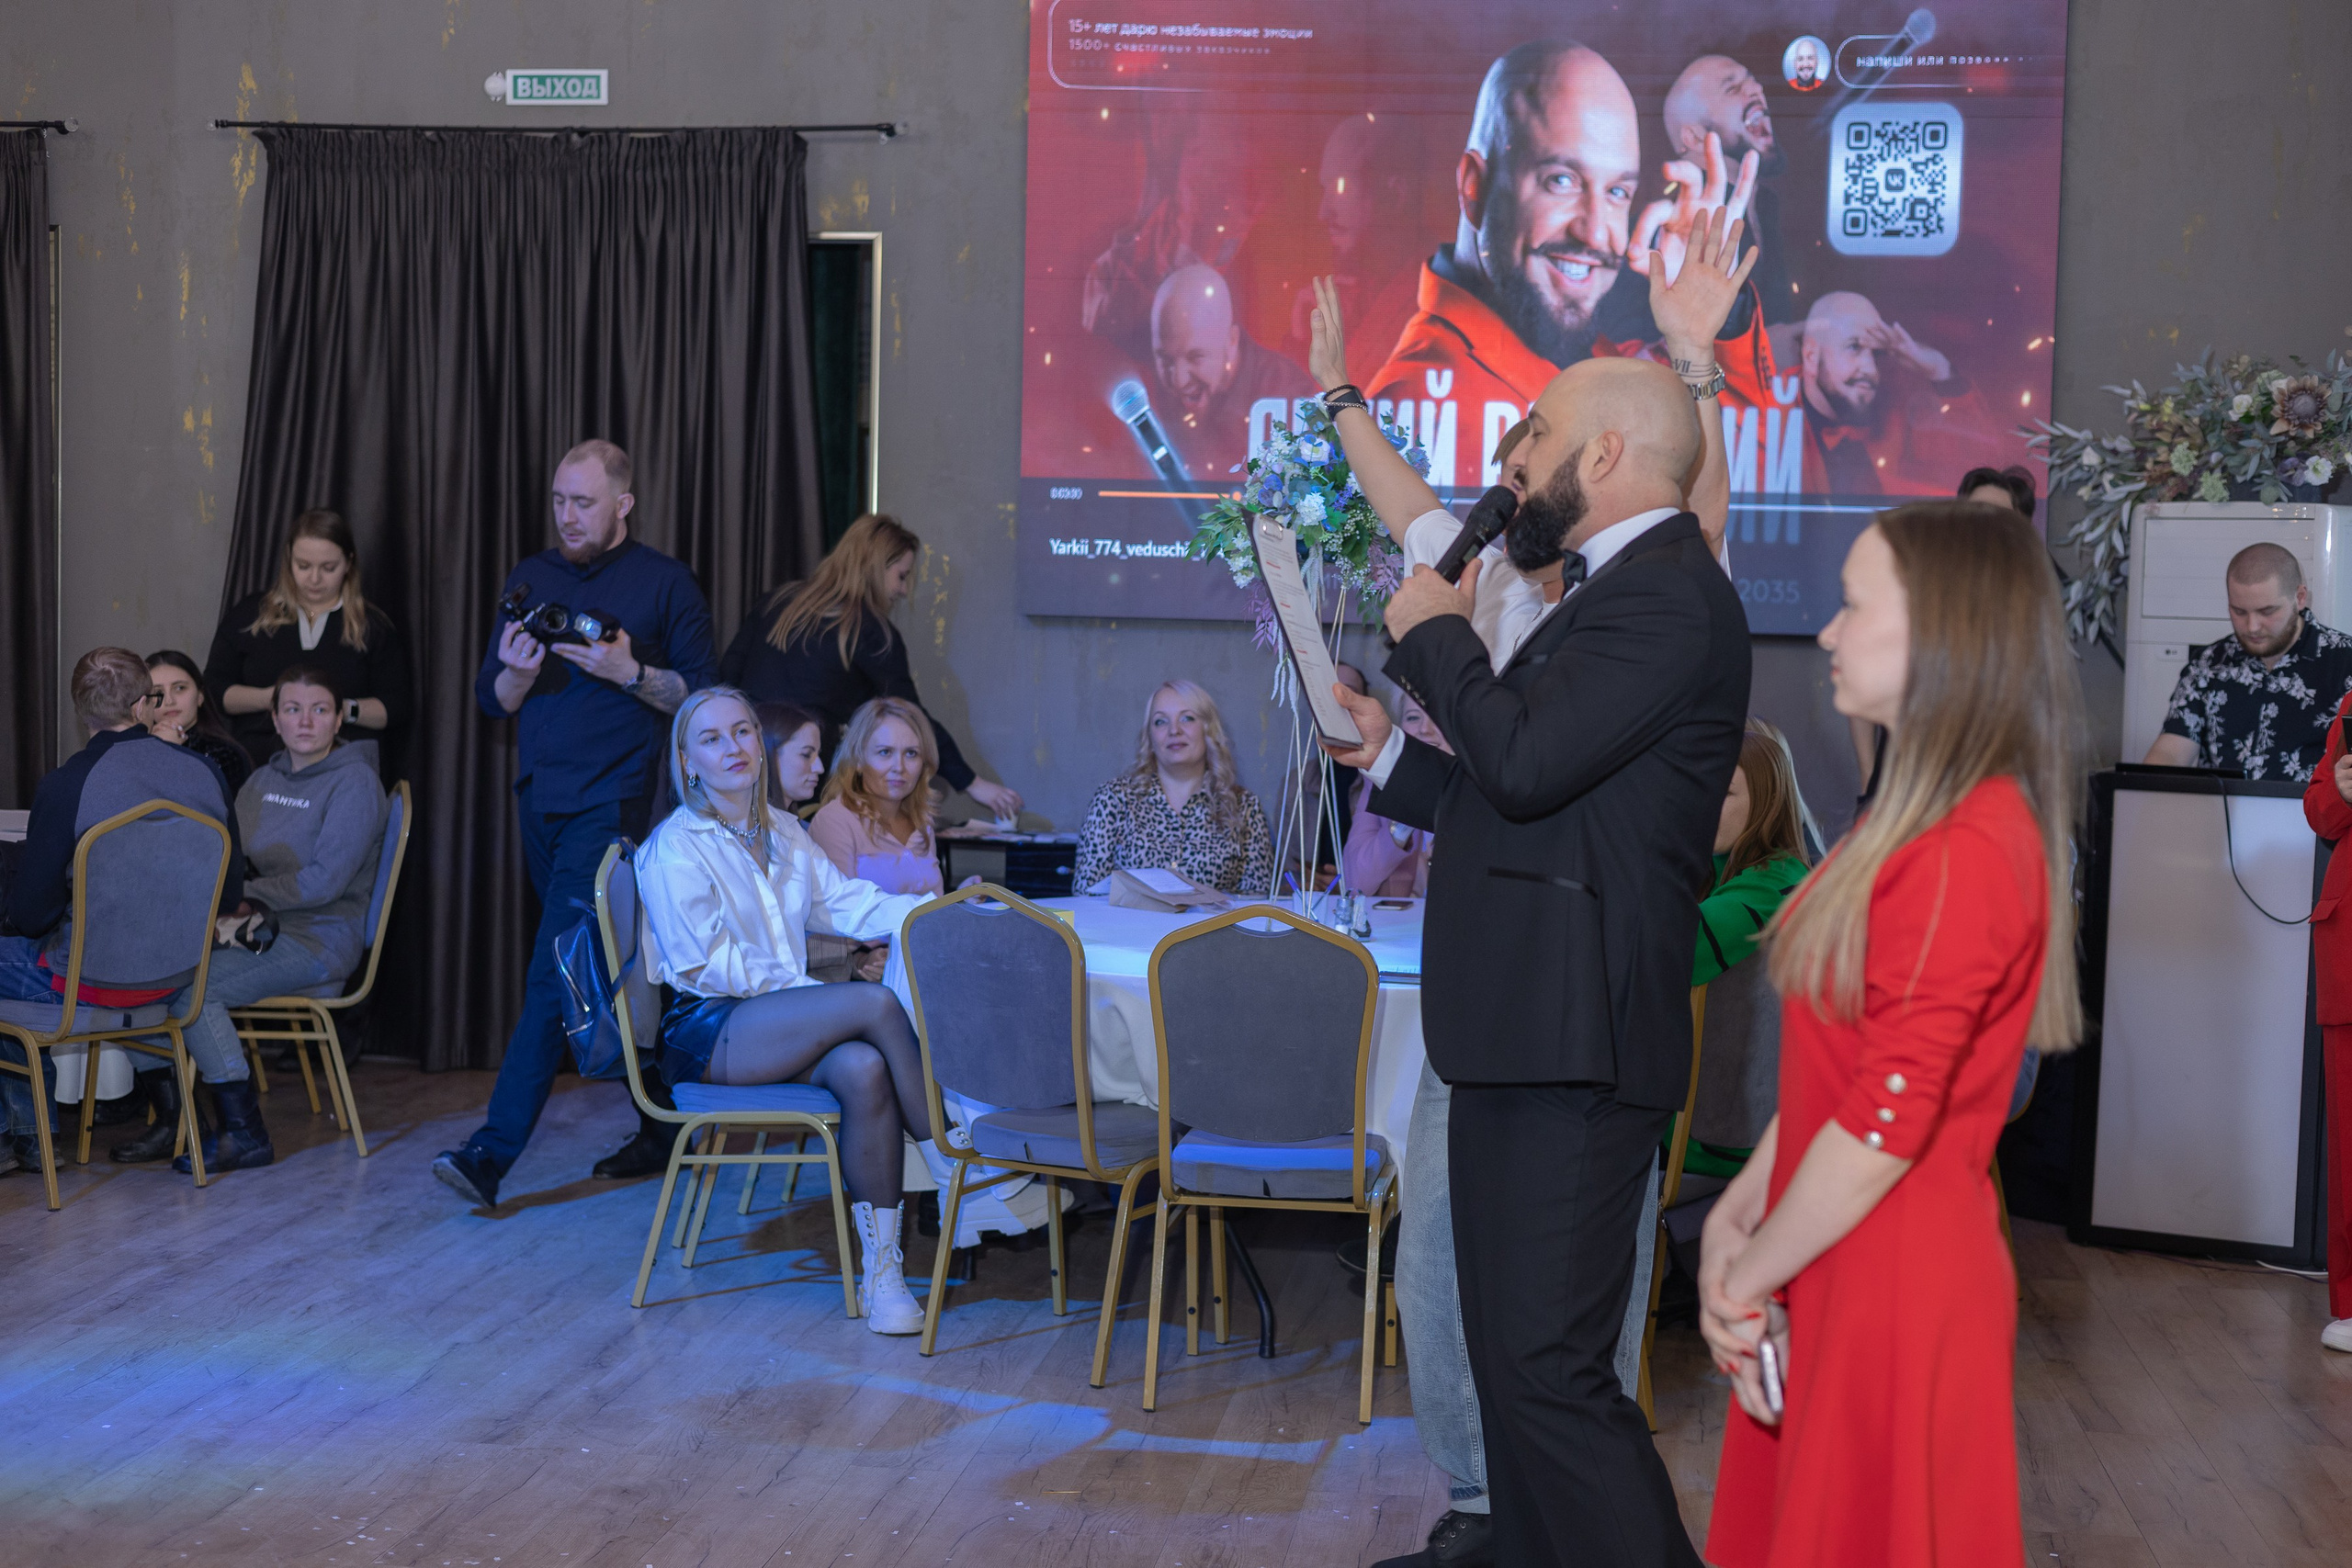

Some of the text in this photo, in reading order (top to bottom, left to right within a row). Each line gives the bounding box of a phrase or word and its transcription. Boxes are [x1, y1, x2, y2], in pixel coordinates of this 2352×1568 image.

[1069, 18, 1091, 33] 15+
[1094, 23, 1118, 34] лет
[1119, 23, 1158, 37] дарю
[1262, 28, 1313, 39] эмоции
[1857, 56, 1913, 67] напиши
[1917, 55, 1943, 66] или
[517, 77, 598, 98] ВЫХОД
